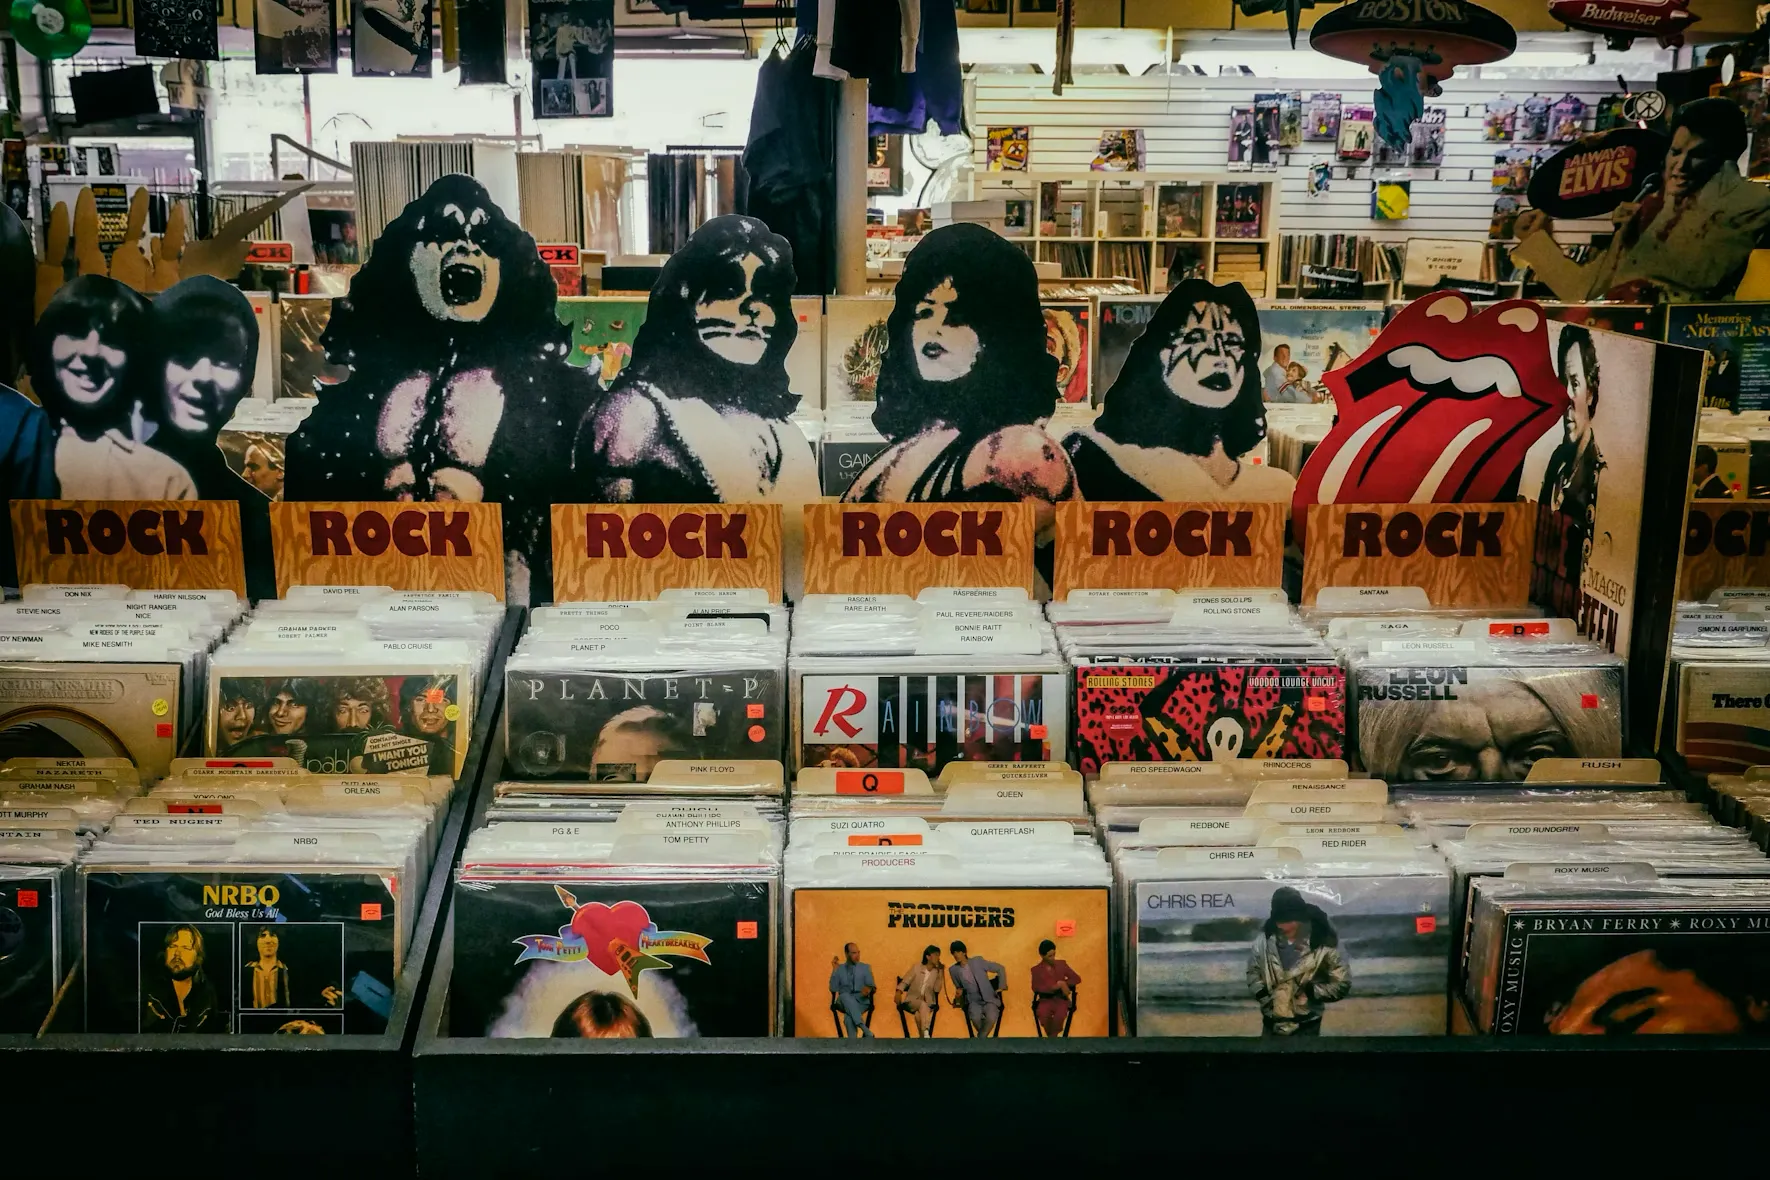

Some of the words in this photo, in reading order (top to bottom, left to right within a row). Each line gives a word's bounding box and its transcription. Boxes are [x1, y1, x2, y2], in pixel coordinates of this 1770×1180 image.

[1357, 0, 1464, 21] BOSTON
[1580, 2, 1662, 26] Budweiser
[1571, 147, 1627, 166] ALWAYS
[1559, 158, 1630, 195] ELVIS
[1697, 312, 1752, 324] Memories
[45, 509, 208, 556] ROCK
[309, 510, 473, 557] ROCK
[586, 512, 748, 559] ROCK
[841, 510, 1004, 557] ROCK
[1092, 510, 1254, 557] ROCK
[1343, 511, 1505, 557] ROCK
[1586, 567, 1626, 607] MAGIC
[1088, 677, 1120, 687] ROLLING
[1122, 677, 1153, 687] STONES
[1248, 676, 1280, 687] VOODOO
[1281, 676, 1310, 687] LOUNGE
[1312, 676, 1336, 687] UNCUT
[1389, 667, 1468, 685] LEON
[1358, 684, 1458, 701] RUSSELL
[1712, 693, 1762, 709] There
[392, 738, 411, 746] SINGLE
[377, 748, 406, 762] WANT
[407, 745, 428, 756] YOU
[386, 755, 429, 771] TONIGHT
[1262, 761, 1312, 769] RHINOCEROS
[1581, 761, 1622, 769] RUSH
[862, 773, 879, 792] Q
[344, 787, 381, 795] ORLEANS
[996, 791, 1024, 799] QUEEN
[14, 811, 49, 819] MURPHY
[1290, 806, 1307, 814] LOU
[552, 827, 565, 835] PG
[706, 820, 741, 828] PHILLIPS
[830, 822, 849, 830] SUZI
[851, 821, 885, 829] QUATRO
[970, 827, 1036, 836] QUARTERFLASH
[1190, 821, 1230, 829] REDBONE
[1508, 826, 1531, 834] TODD
[1533, 826, 1580, 834] RUNDGREN
[1321, 840, 1338, 848] RED
[1339, 839, 1367, 847] RIDER
[861, 858, 916, 867] PRODUCERS
[1209, 852, 1235, 860] CHRIS
[1236, 851, 1255, 859] REA
[203, 884, 280, 908] NRBQ
[1147, 894, 1197, 910] CHRIS
[1201, 893, 1235, 908] REA
[205, 908, 224, 919] God
[225, 908, 250, 919] Bless
[252, 908, 264, 919] Us
[265, 907, 279, 918] All
[887, 901, 1015, 928] PRODUCERS
[1533, 918, 1595, 930] BRYAN
[1602, 918, 1663, 930] FERRY
[1689, 917, 1741, 929] ROXY
[641, 932, 701, 951] HEARTBREAKERS
[1506, 937, 1524, 993] MUSIC
